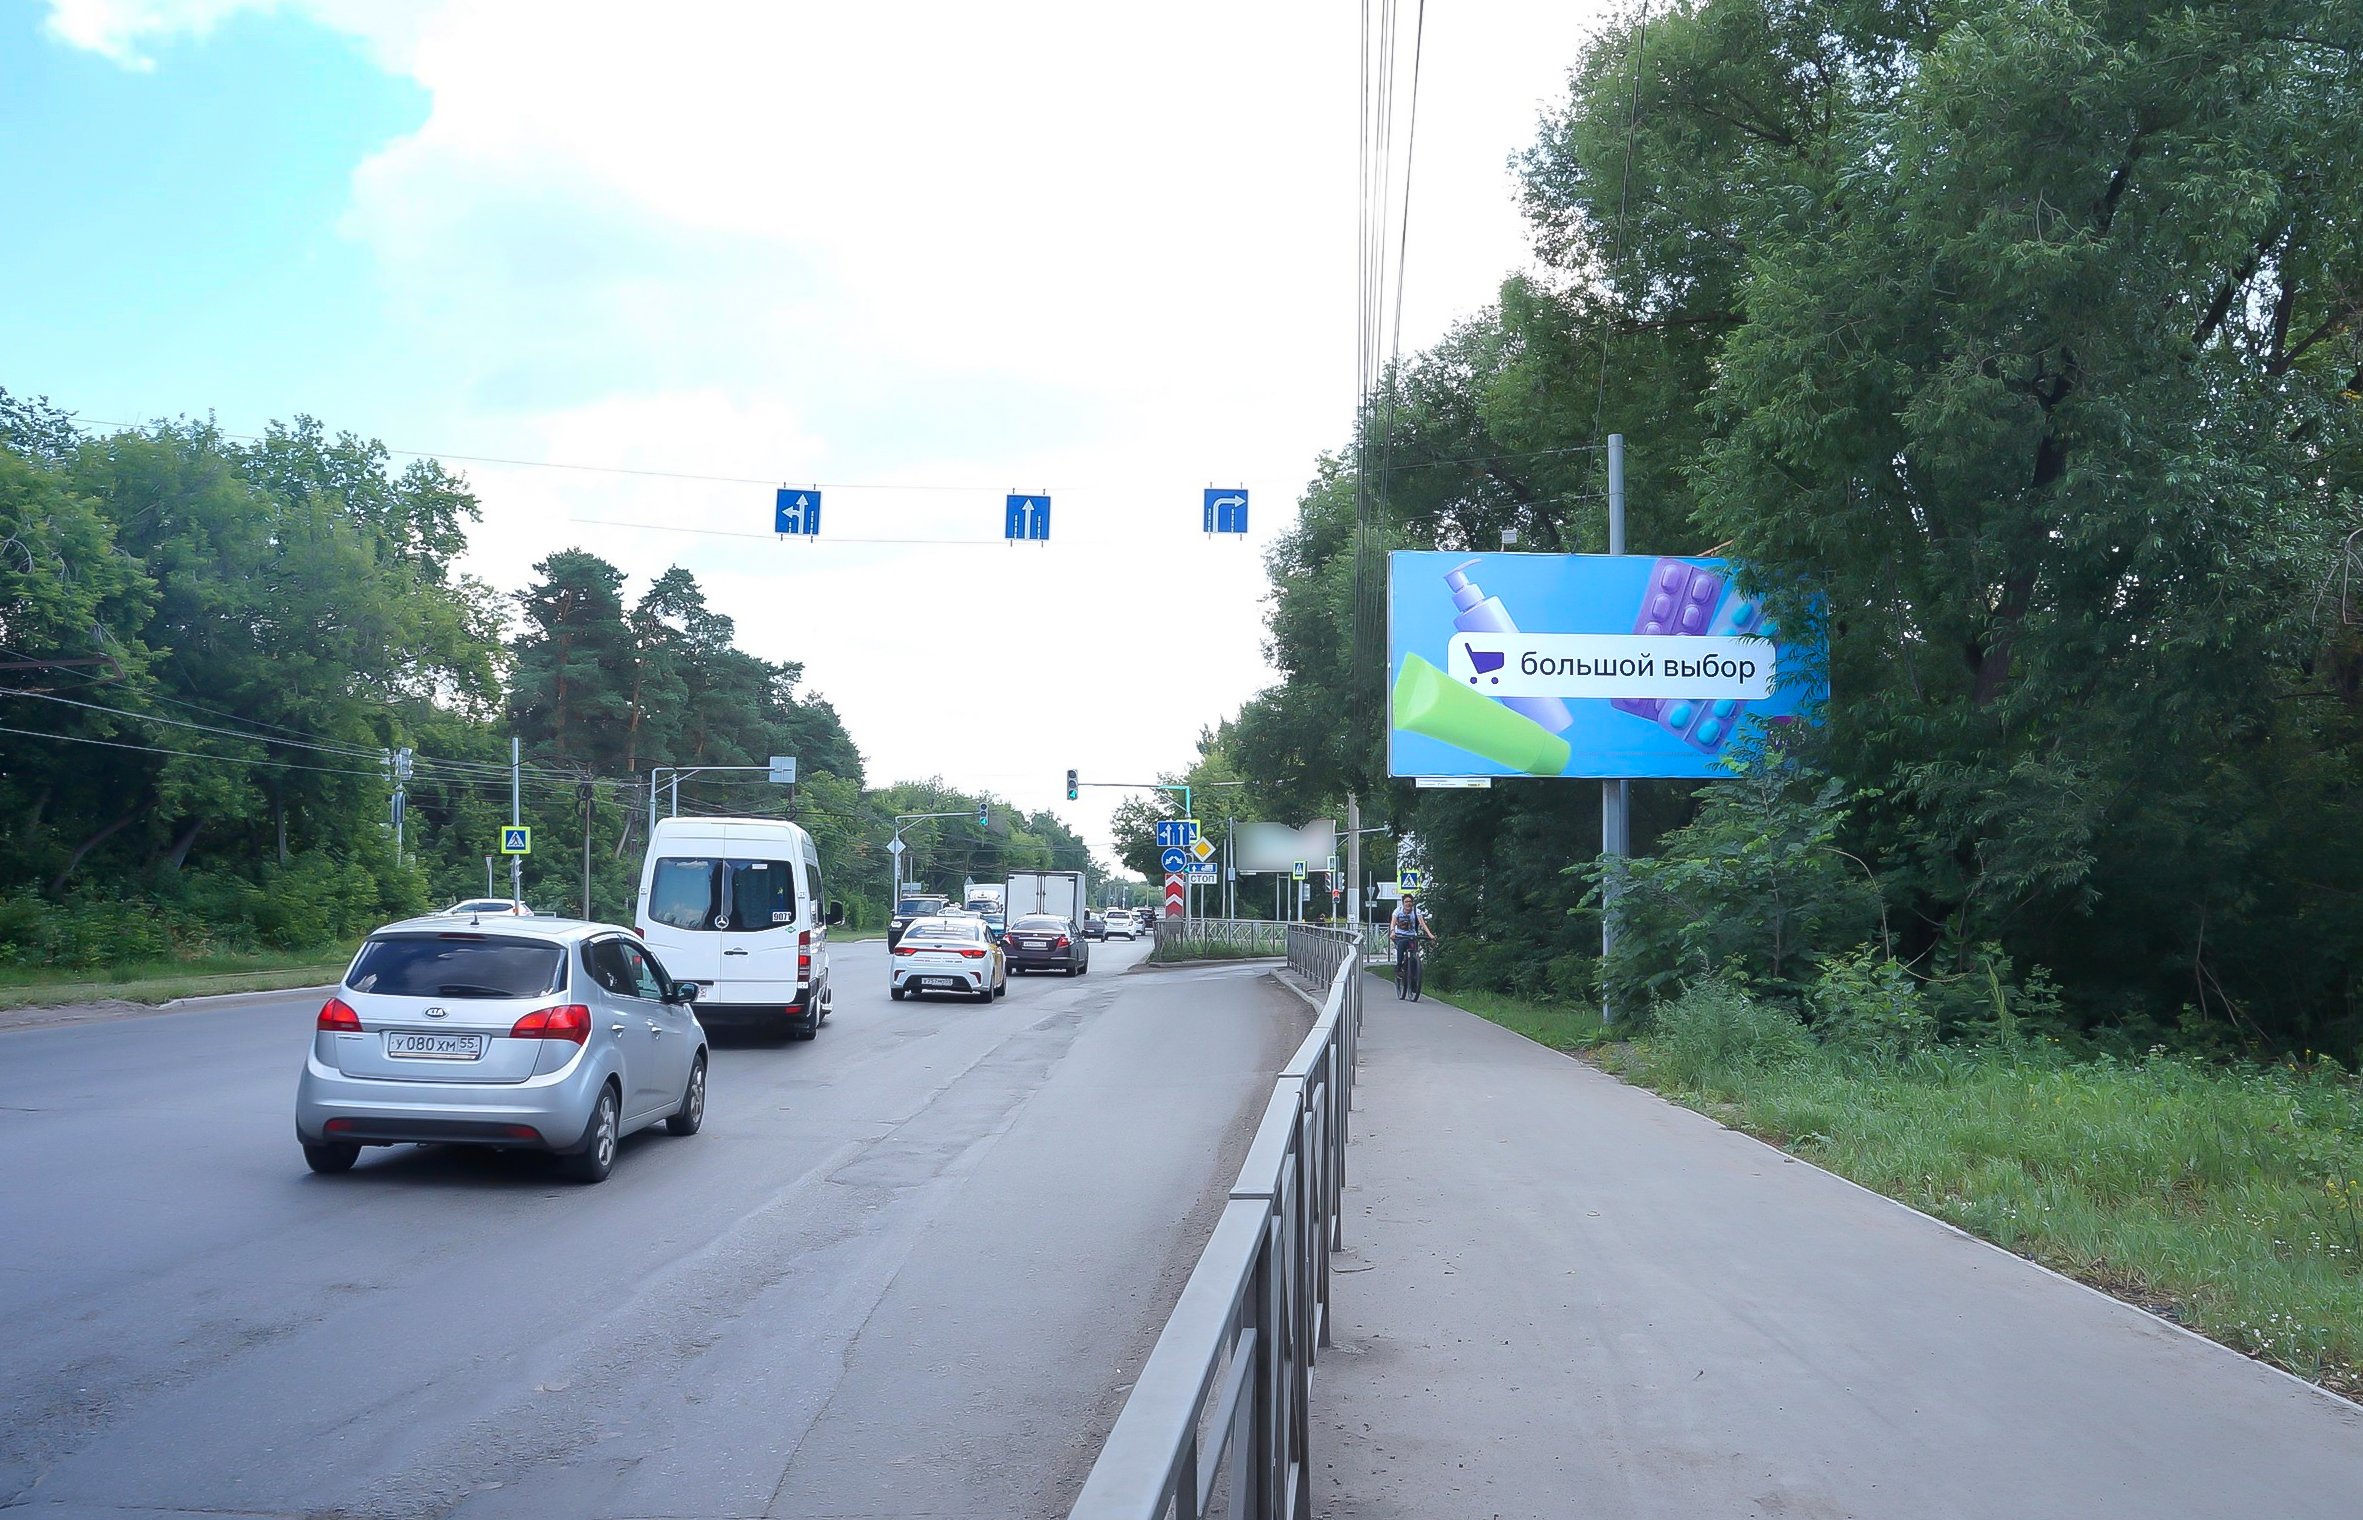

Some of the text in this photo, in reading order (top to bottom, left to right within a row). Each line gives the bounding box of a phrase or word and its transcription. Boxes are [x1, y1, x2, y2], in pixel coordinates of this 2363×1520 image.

[1521, 651, 1756, 684] большой выбор
[1190, 874, 1215, 883] СТОП
[427, 1008, 444, 1016] KIA
[406, 1037, 435, 1051] 080
[460, 1038, 475, 1049] 55
